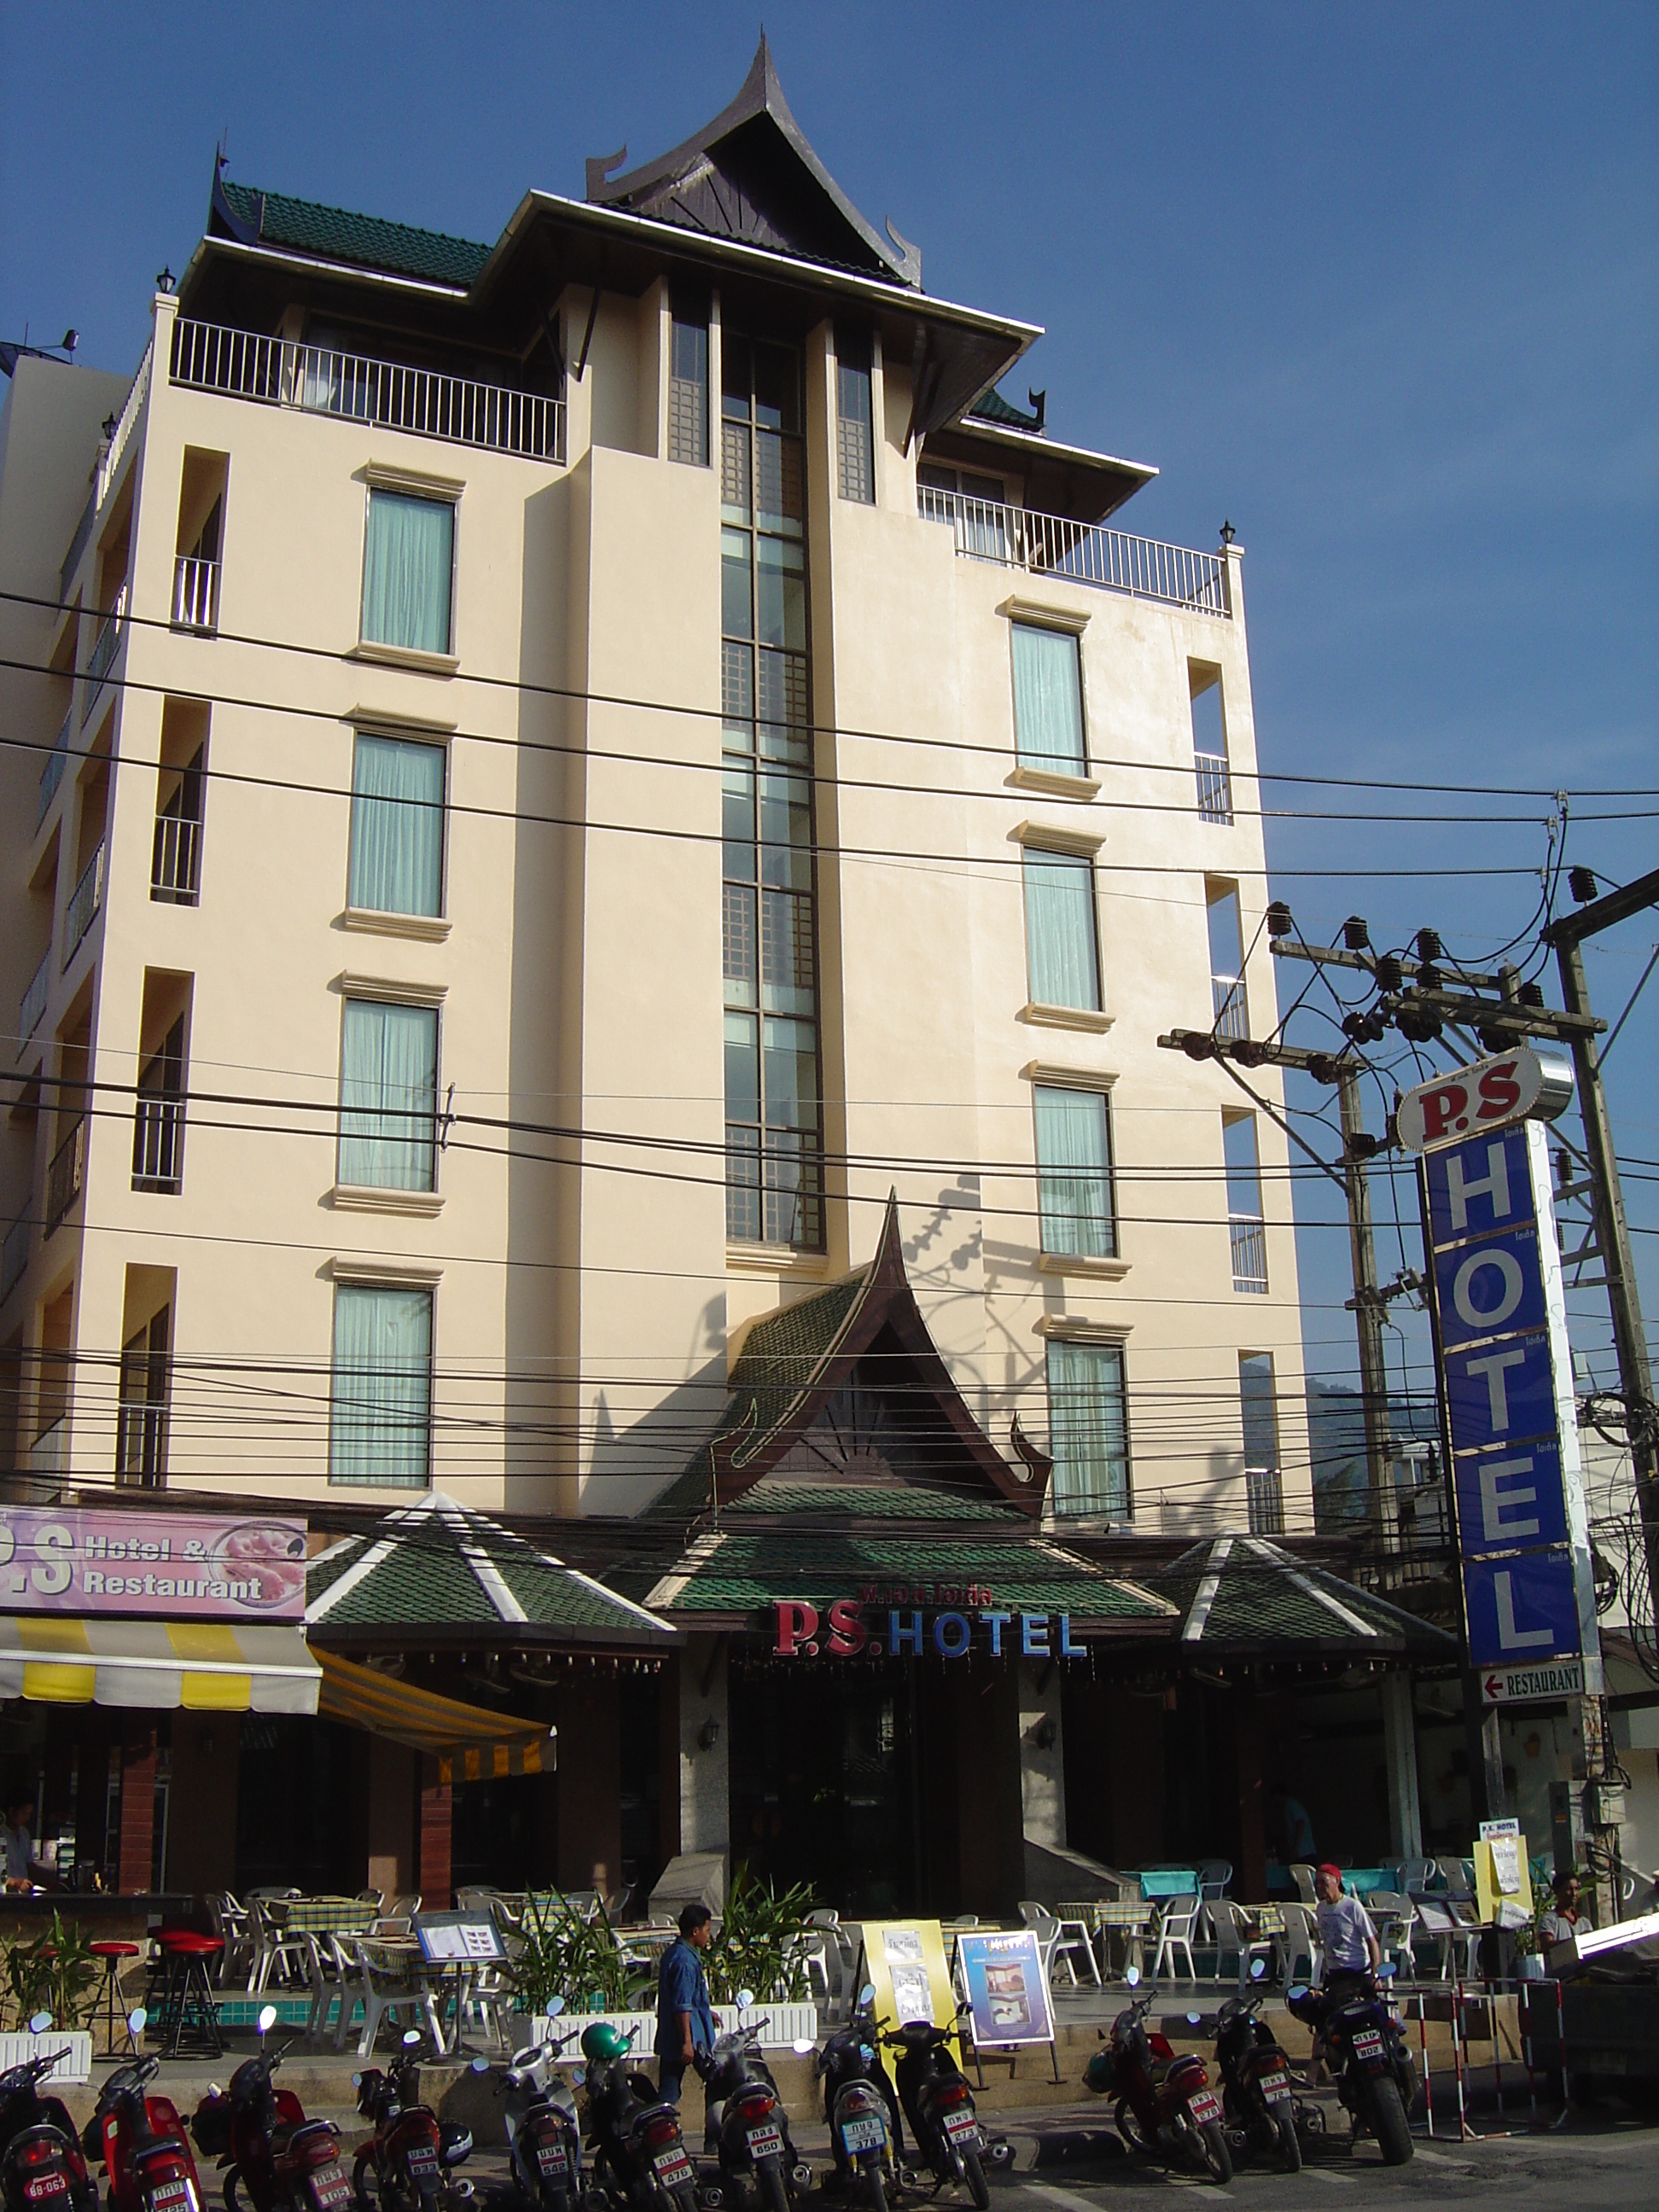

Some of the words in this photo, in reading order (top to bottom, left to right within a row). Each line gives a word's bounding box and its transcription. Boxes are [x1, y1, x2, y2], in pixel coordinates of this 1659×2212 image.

[1418, 1061, 1521, 1143] P.S
[1447, 1141, 1554, 1650] HOTEL
[84, 1535, 171, 1561] Hotel
[182, 1540, 208, 1562] &
[83, 1571, 262, 1600] Restaurant
[772, 1598, 882, 1656] P.S.
[888, 1610, 1087, 1657] HOTEL
[1506, 1667, 1580, 1697] RESTAURANT
[856, 2137, 876, 2150] 378
[955, 2129, 975, 2141] 273
[544, 2163, 566, 2174] 542
[326, 2188, 346, 2203] 105
